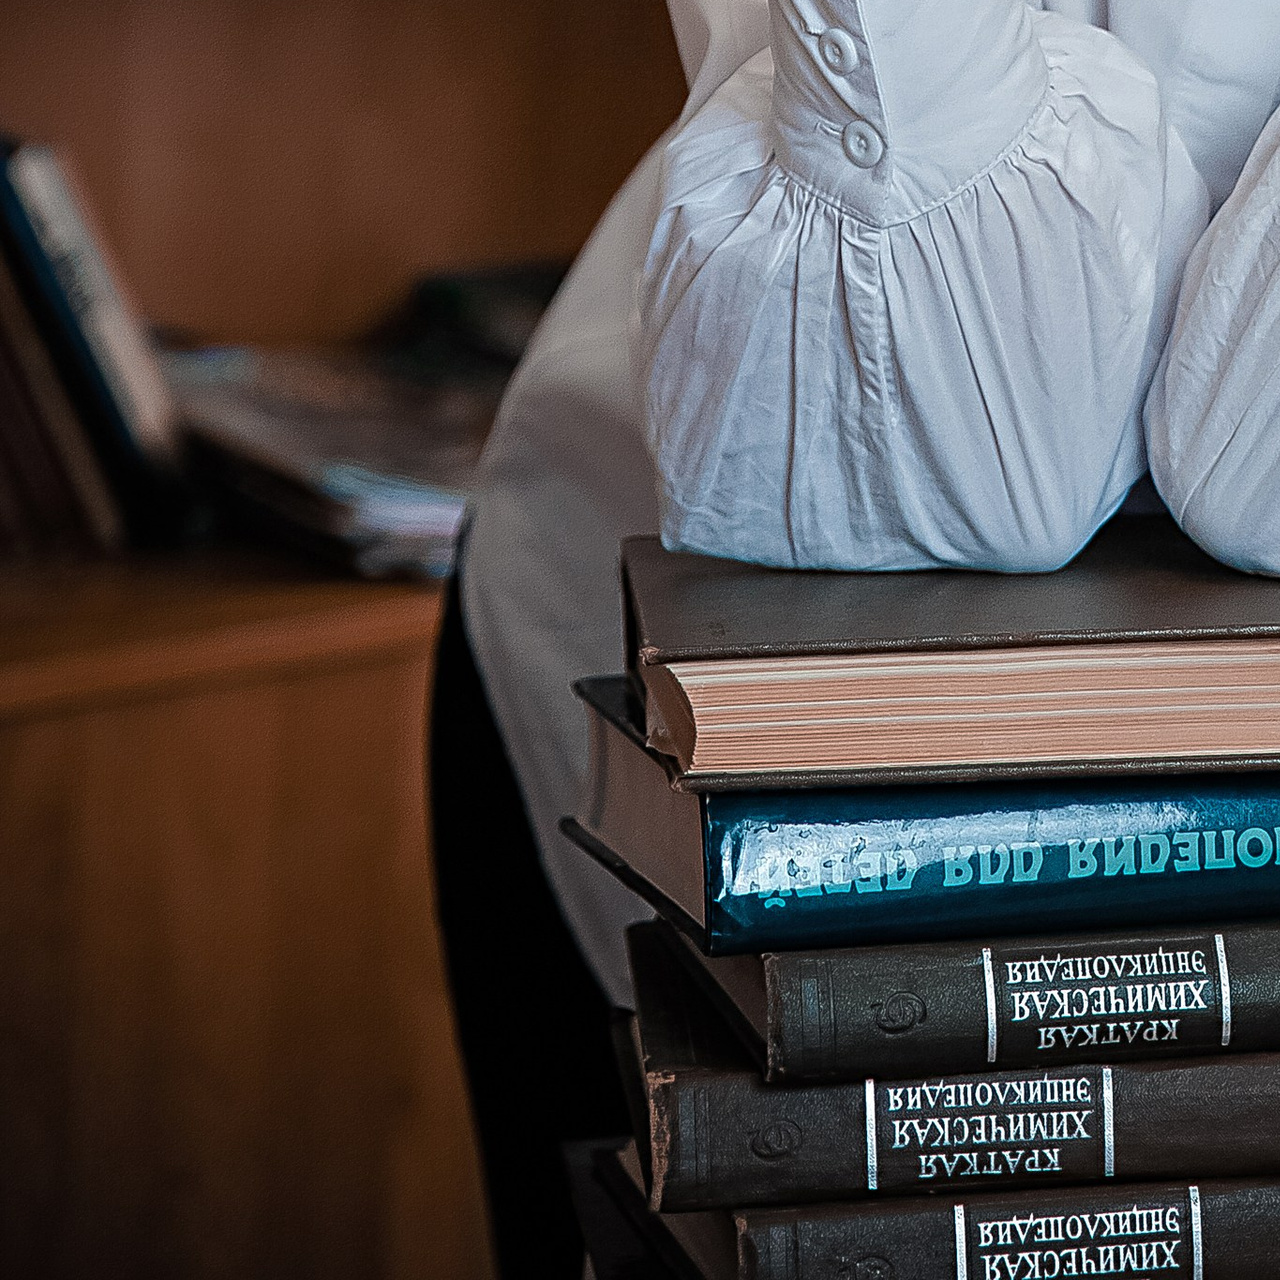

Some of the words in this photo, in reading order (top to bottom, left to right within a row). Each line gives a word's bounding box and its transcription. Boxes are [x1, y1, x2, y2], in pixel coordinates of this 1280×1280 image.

[942, 840, 1045, 888] ДЛЯ
[1004, 946, 1208, 985] ЭНЦИКЛОПЕДИЯ
[1010, 979, 1210, 1023] ХИМИЧЕСКАЯ
[1037, 1018, 1180, 1050] КРАТКАЯ
[886, 1072, 1092, 1112] ЭНЦИКЛОПЕДИЯ
[891, 1108, 1094, 1149] ХИМИЧЕСКАЯ
[917, 1147, 1064, 1179] КРАТКАЯ
[977, 1204, 1181, 1248] ЭНЦИКЛОПЕДИЯ
[980, 1240, 1182, 1280] ХИМИЧЕСКАЯ
